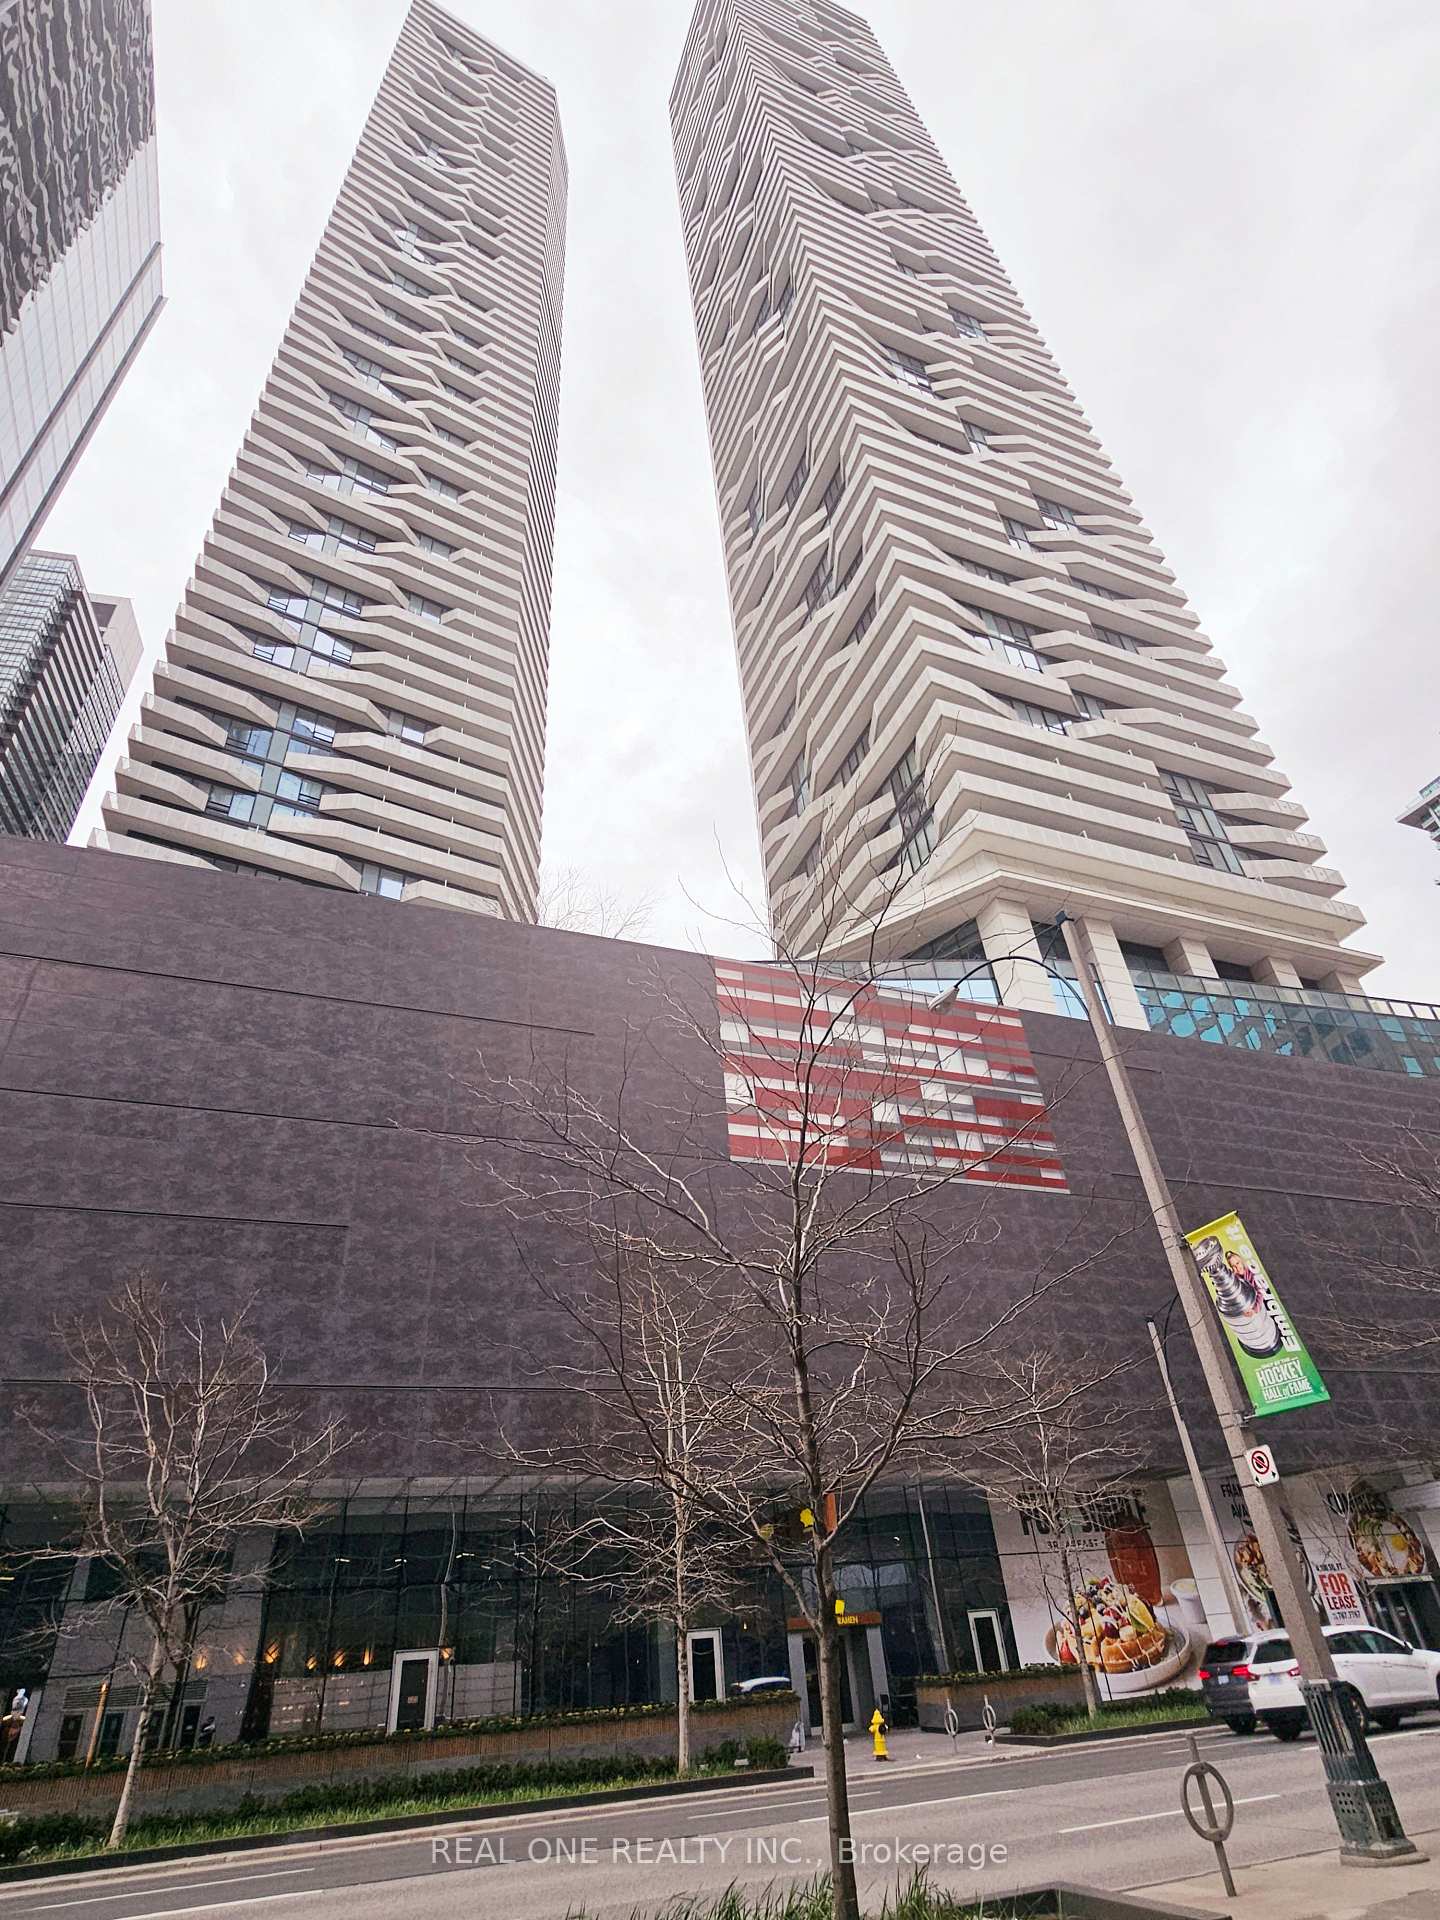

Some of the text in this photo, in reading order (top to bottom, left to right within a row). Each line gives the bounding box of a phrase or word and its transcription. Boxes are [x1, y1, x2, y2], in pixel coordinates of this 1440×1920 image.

[1239, 1244, 1301, 1352] Embrace
[1256, 1360, 1303, 1388] HOCKEY
[1262, 1385, 1282, 1401] HALL
[1288, 1378, 1312, 1396] FAME
[1318, 1572, 1353, 1596] FOR
[1326, 1594, 1358, 1611] LEASE
